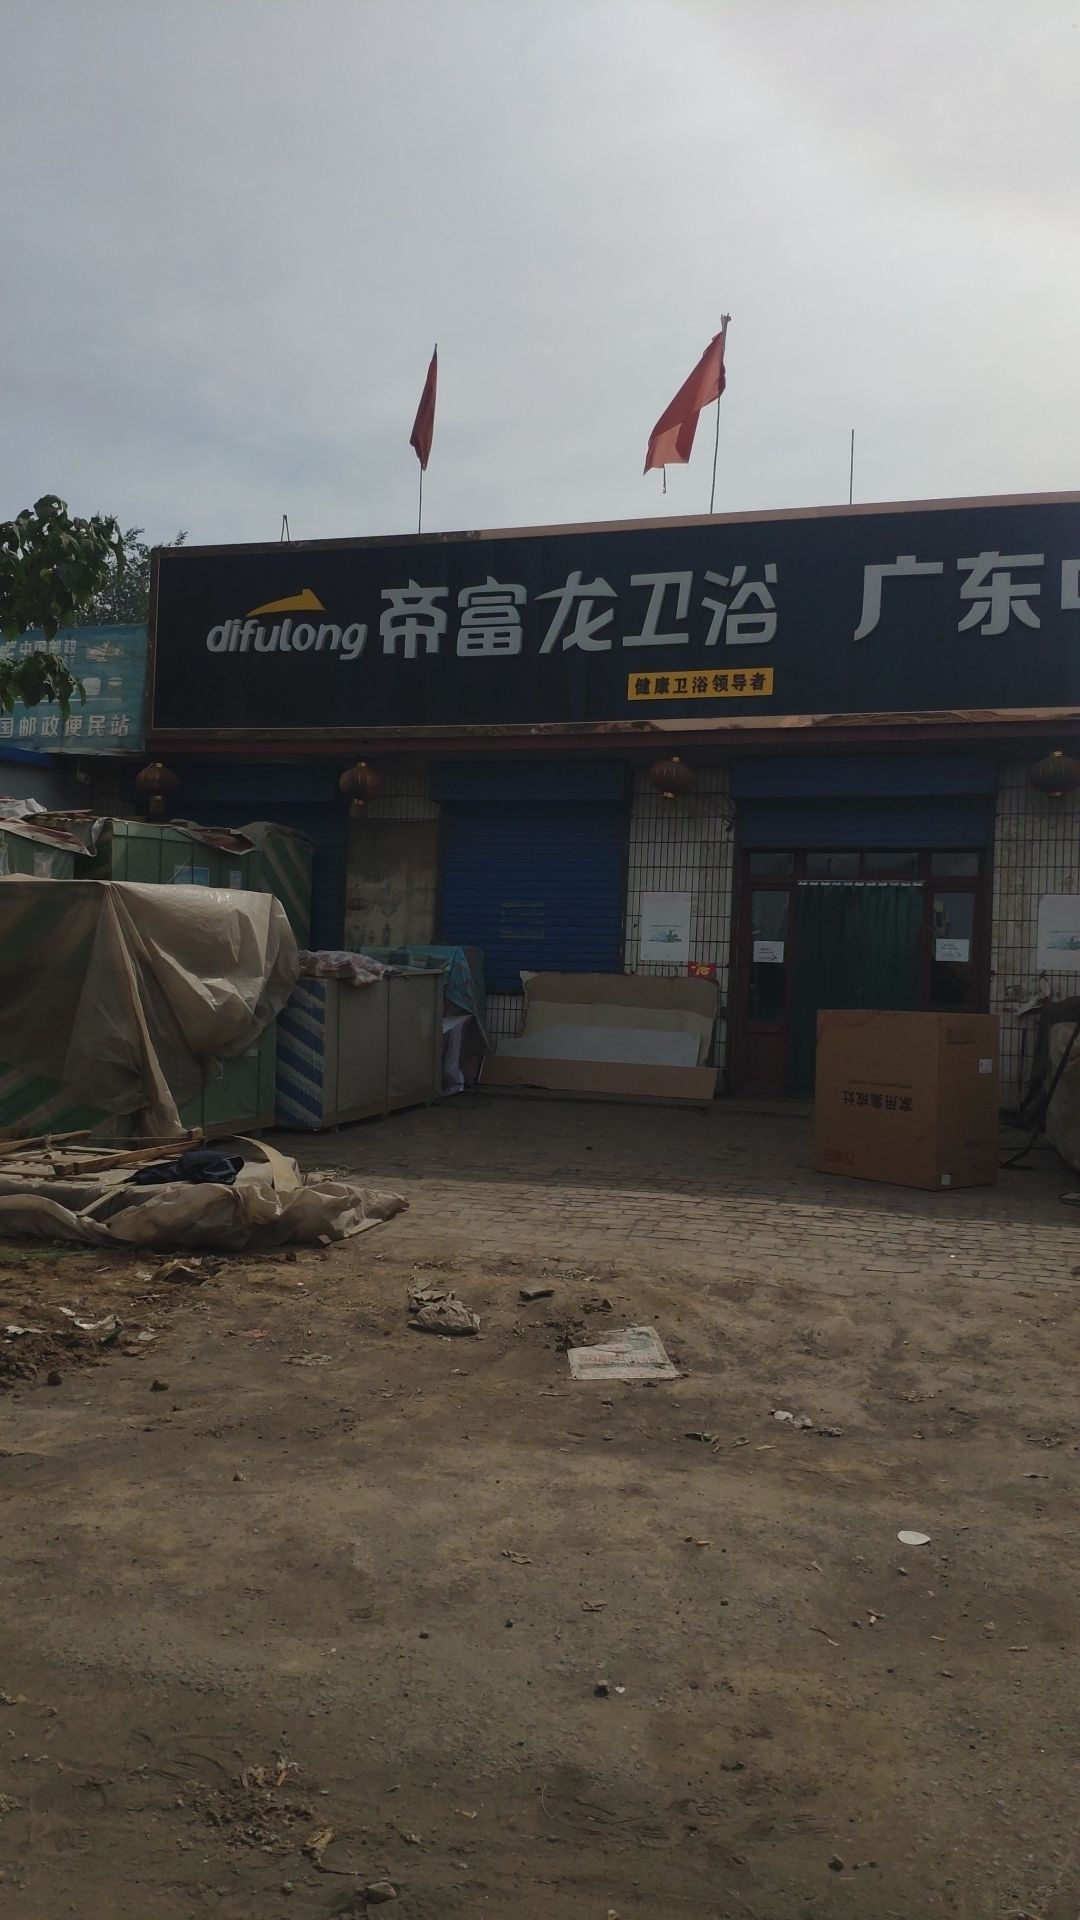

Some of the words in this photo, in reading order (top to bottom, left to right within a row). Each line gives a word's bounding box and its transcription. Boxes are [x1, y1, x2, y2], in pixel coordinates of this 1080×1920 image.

[380, 562, 777, 659] 帝富龙卫浴
[853, 551, 1080, 642] 广东
[206, 618, 369, 661] difulong
[635, 672, 766, 696] 健康卫浴领导者
[841, 1090, 913, 1113] 家用集成灶
